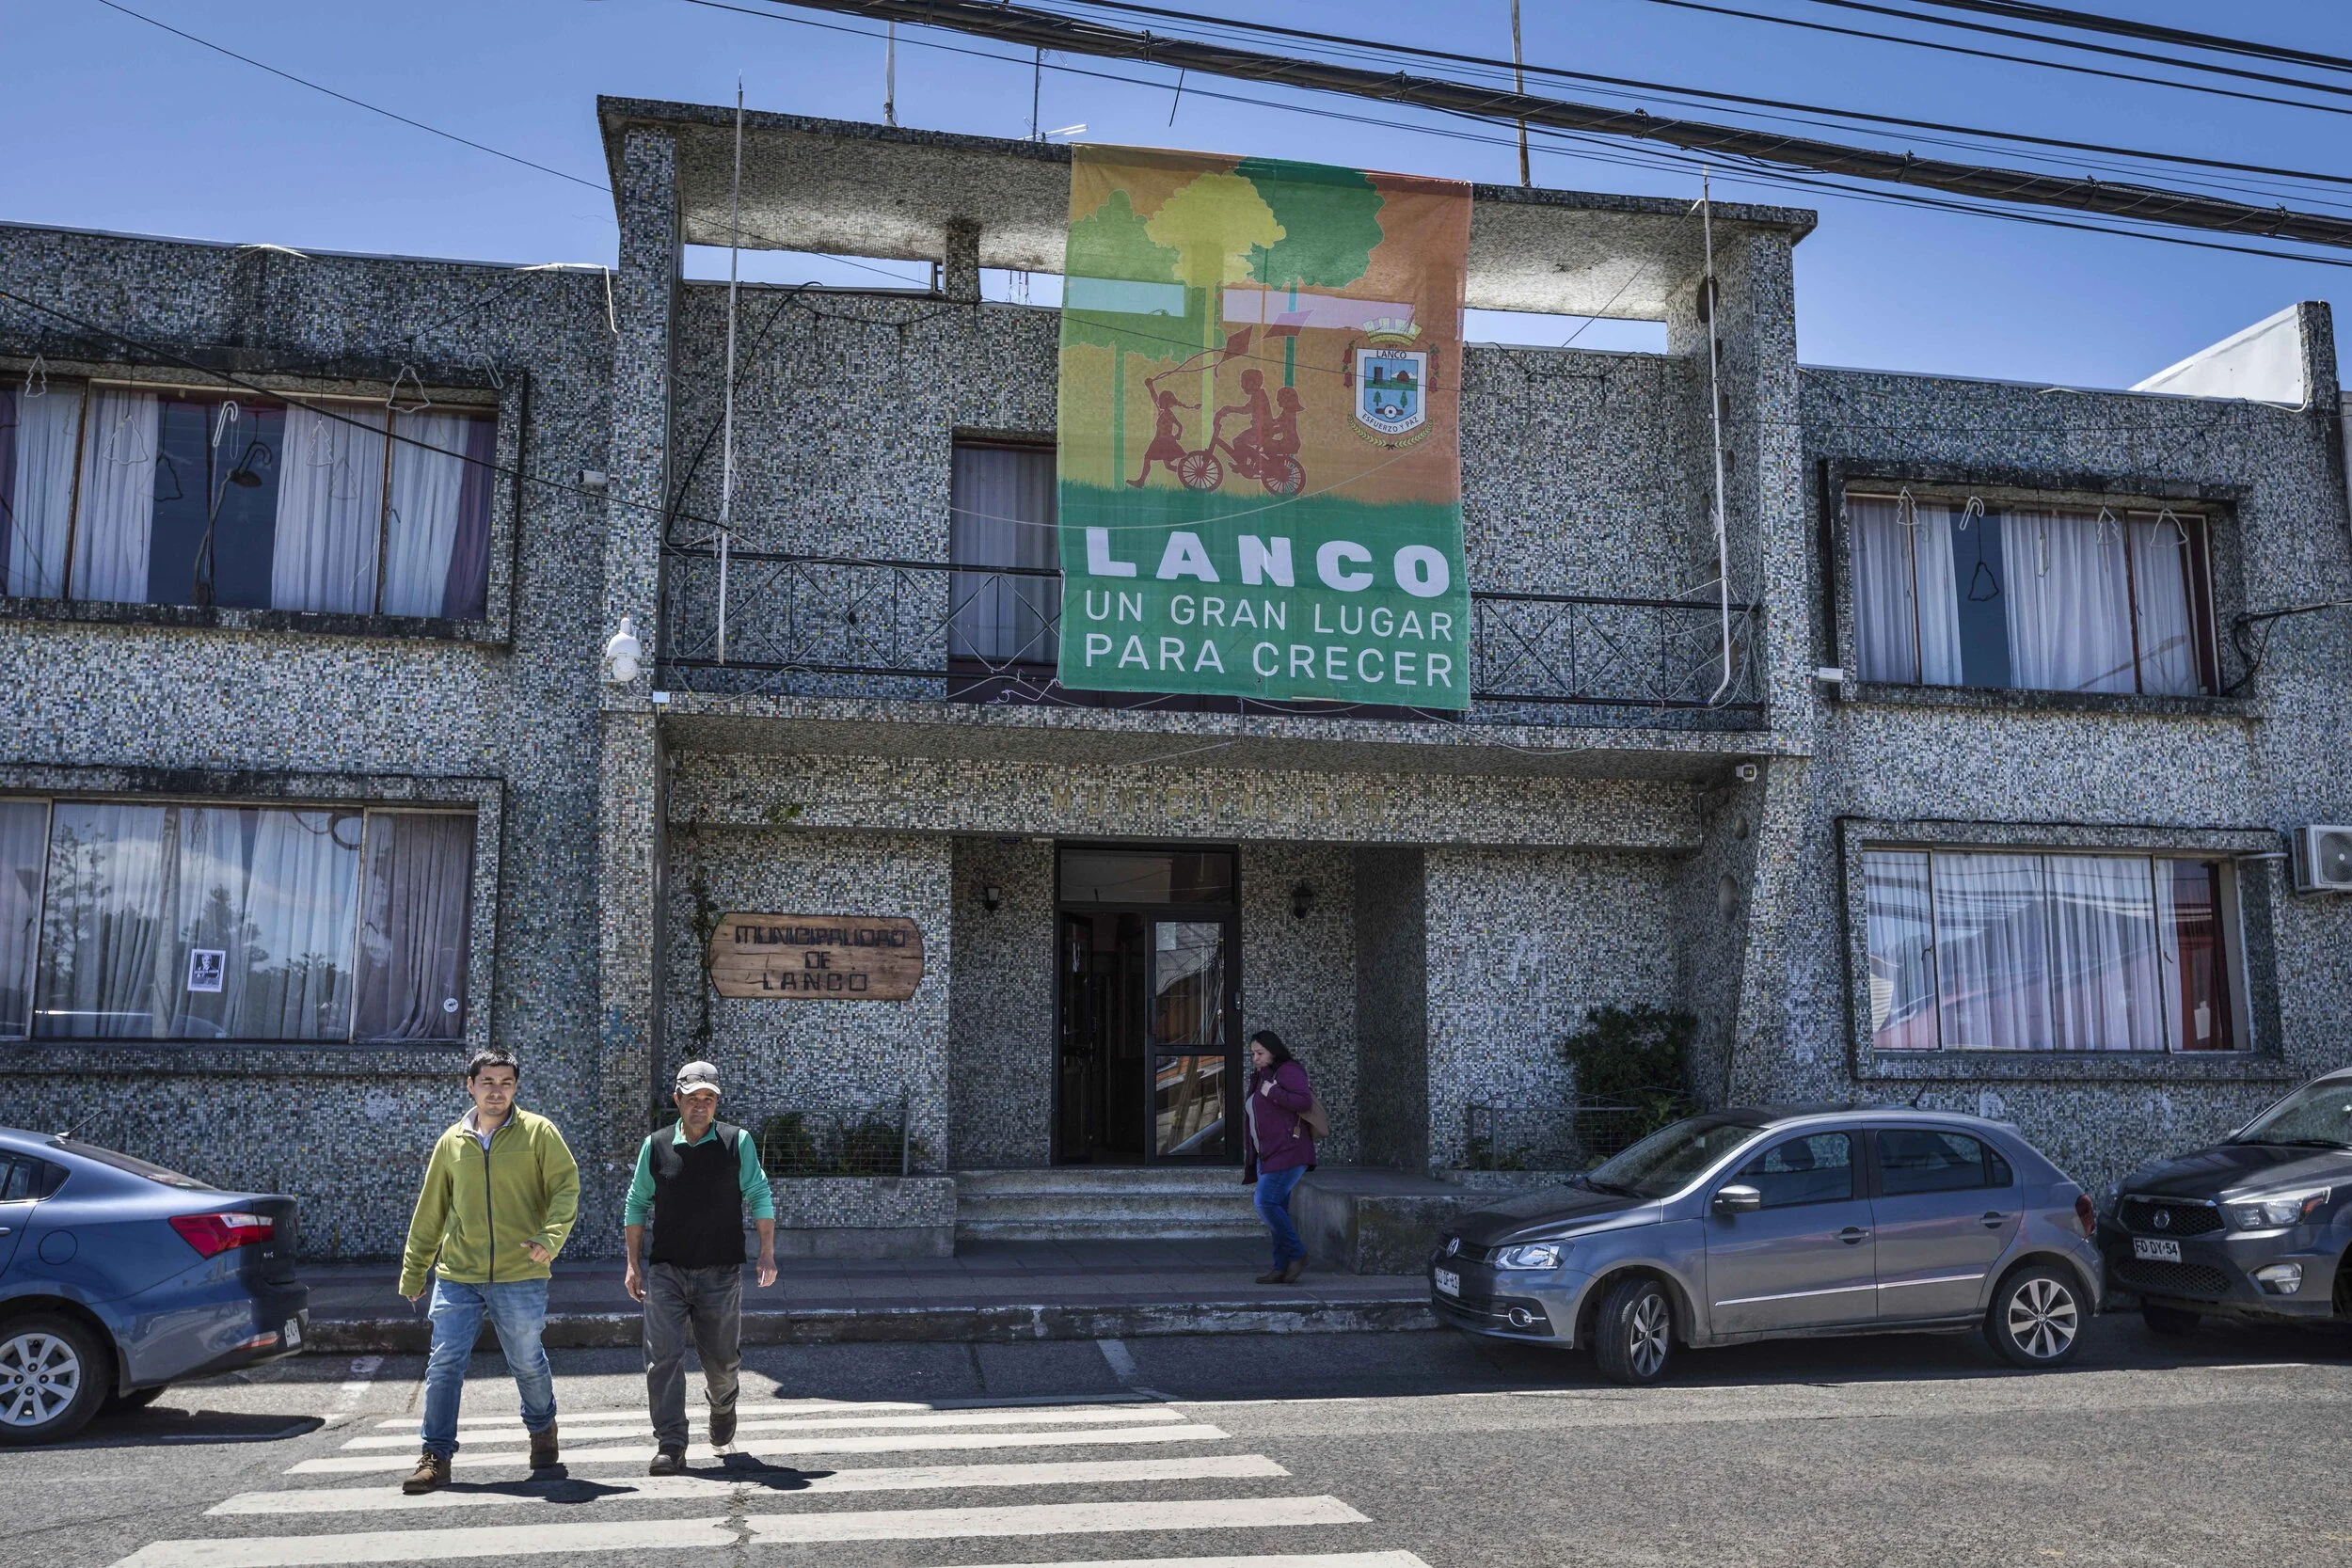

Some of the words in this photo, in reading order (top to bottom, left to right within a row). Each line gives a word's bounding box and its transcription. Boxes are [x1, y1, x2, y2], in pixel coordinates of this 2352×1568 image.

[1376, 350, 1407, 359] LANCO
[1361, 413, 1398, 433] ESFUERZO
[1405, 416, 1419, 428] PAZ
[1086, 527, 1450, 597] LANCO
[1086, 590, 1142, 622] UN
[1170, 594, 1286, 630] GRAN
[1315, 604, 1453, 641] LUGAR
[1086, 633, 1225, 673] PARA
[1252, 642, 1453, 688] CRECER
[1053, 784, 1385, 821] MUNICIPALIDAD
[735, 926, 908, 947] MUNICIPALIDAD
[804, 950, 831, 969] DE
[762, 973, 867, 991] LANCO
